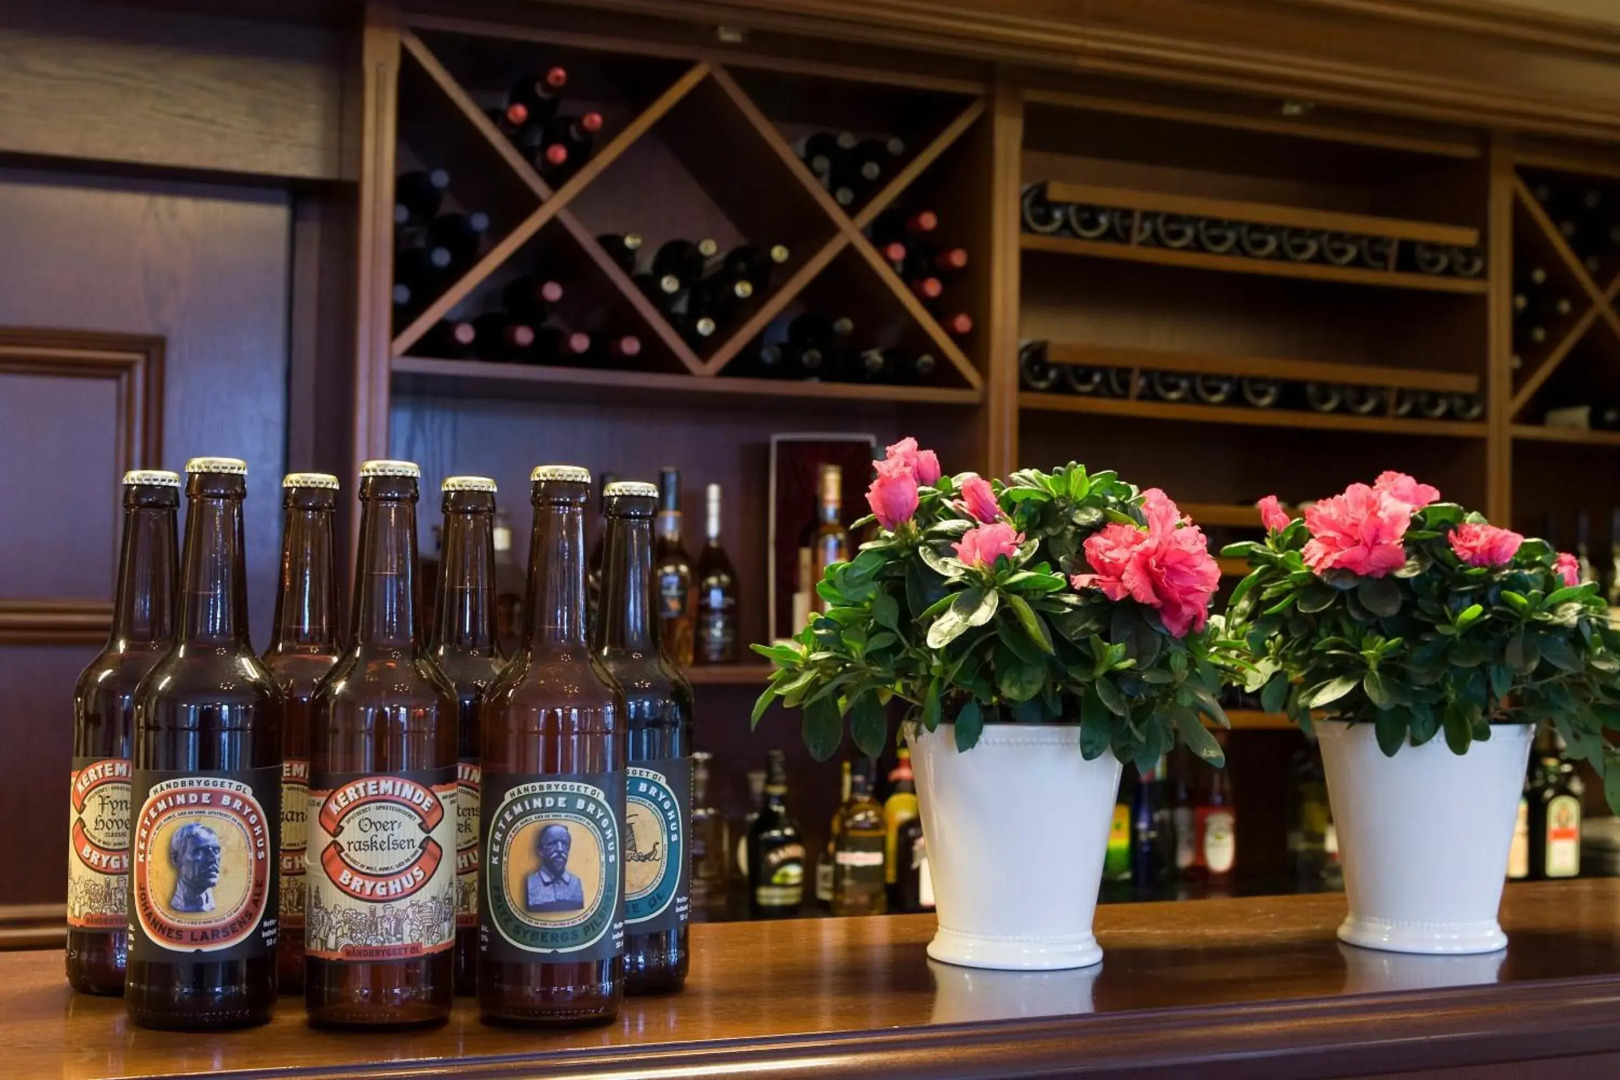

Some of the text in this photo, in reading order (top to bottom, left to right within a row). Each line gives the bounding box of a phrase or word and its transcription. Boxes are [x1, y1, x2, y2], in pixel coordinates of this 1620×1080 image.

[76, 763, 132, 794] KERTEMI
[152, 779, 248, 795] HÅNDBRYGGET ØL
[510, 783, 588, 798] HÅNDBRYGGET
[328, 780, 434, 814] KERTEMINDE
[638, 782, 678, 843] BRYGHUS
[138, 793, 211, 863] KERTEMINDE
[221, 795, 265, 860] BRYGHUS
[346, 834, 416, 852] raskelsen
[491, 797, 566, 865] KERTEMINDE
[576, 798, 615, 863] BRYGHUS
[338, 866, 426, 897] BRYGHUS
[139, 882, 184, 941] JOHANNES
[190, 912, 253, 942] LARSENS
[345, 946, 408, 958] HÅNDBRYGGET
